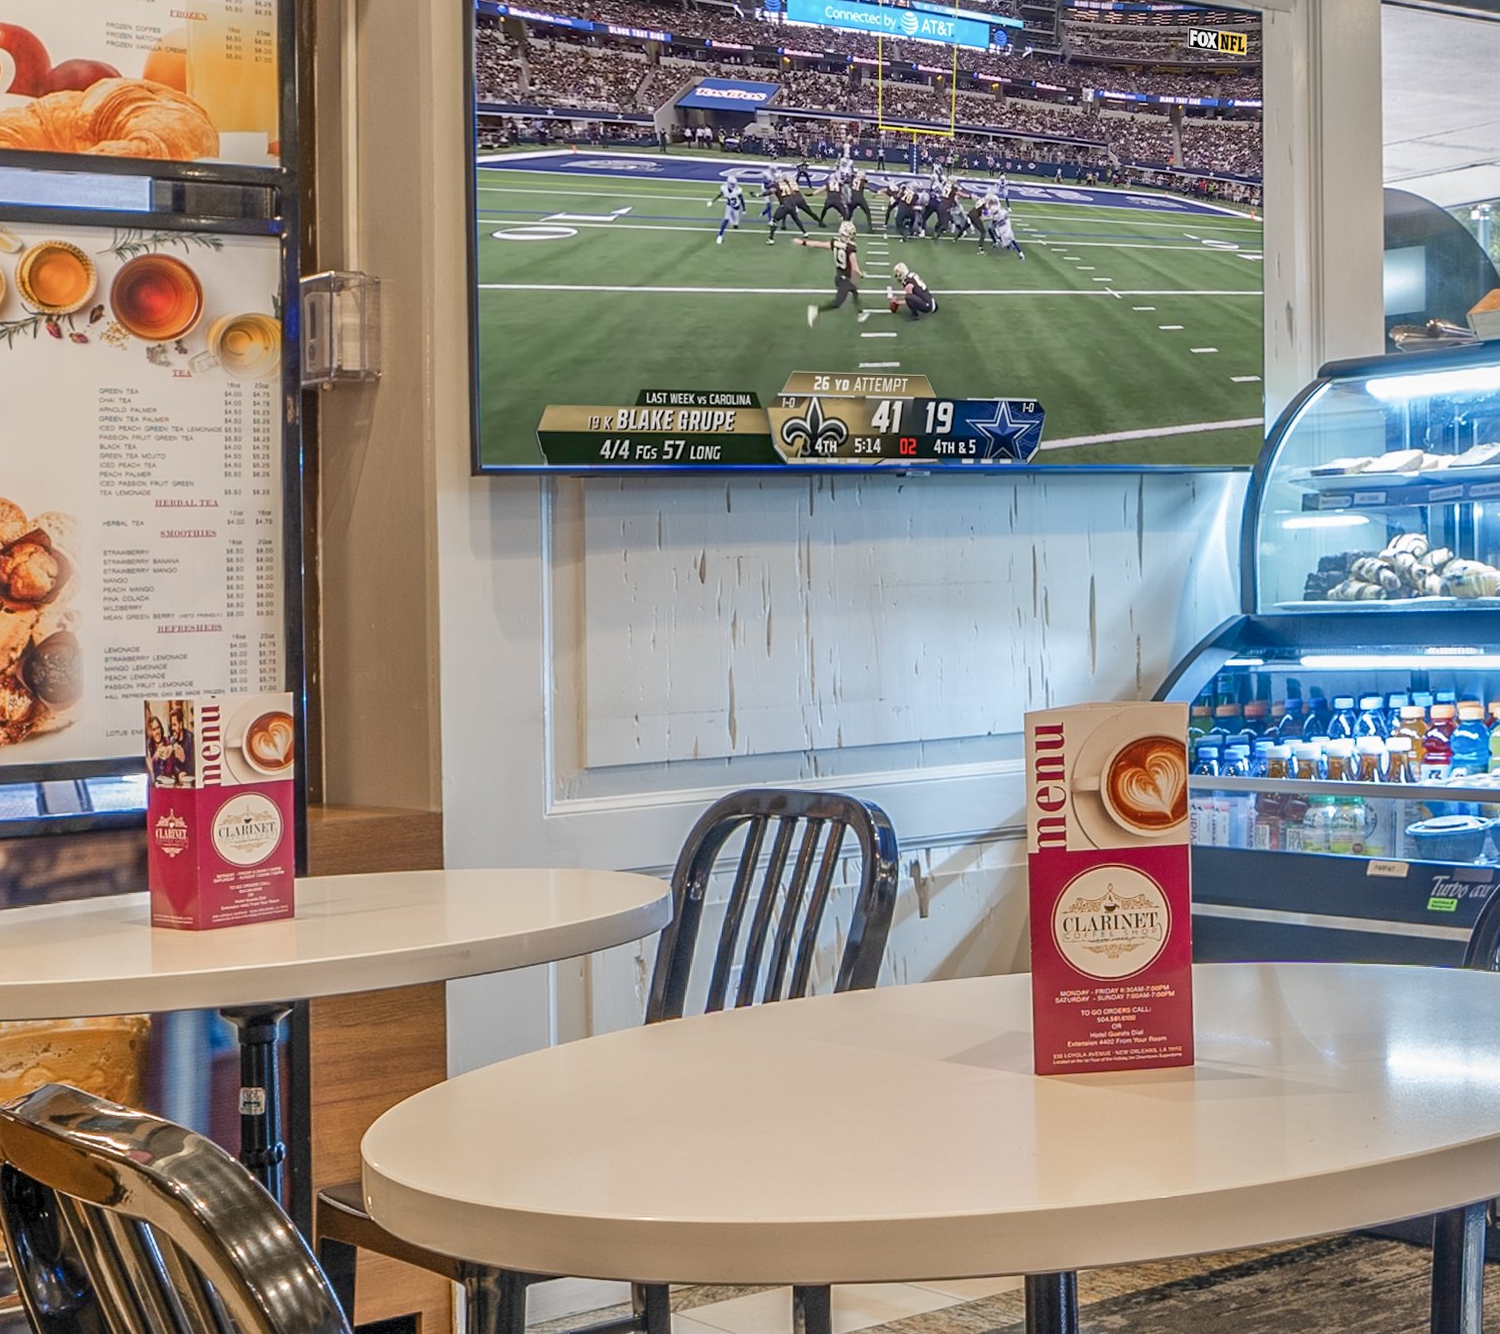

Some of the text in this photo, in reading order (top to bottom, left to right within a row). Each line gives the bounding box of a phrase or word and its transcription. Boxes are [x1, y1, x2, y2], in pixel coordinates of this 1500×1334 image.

[825, 5, 954, 37] Connected by AT&T
[1189, 29, 1245, 53] FOX NFL
[814, 376, 908, 393] 26 YD ATTEMPT
[646, 392, 751, 405] LAST WEEK vs CAROLINA
[782, 397, 795, 408] 1-0
[1022, 403, 1034, 413] 1-0
[604, 417, 613, 430] K
[617, 409, 674, 431] BLAKE
[678, 410, 736, 431] GRUPE
[871, 400, 954, 434] 41 19
[600, 440, 721, 460] 4/4 FGs 57 LONG
[815, 438, 976, 454] 4TH 5:14 02 4TH & 5
[200, 499, 219, 507] TEA
[202, 705, 221, 788] menu
[1035, 722, 1068, 851] menu
[218, 821, 276, 840] CLARINET
[1432, 875, 1469, 899] Turbo
[1063, 911, 1158, 932] CLARINET
[1064, 928, 1157, 939] COFFEE SHOP
